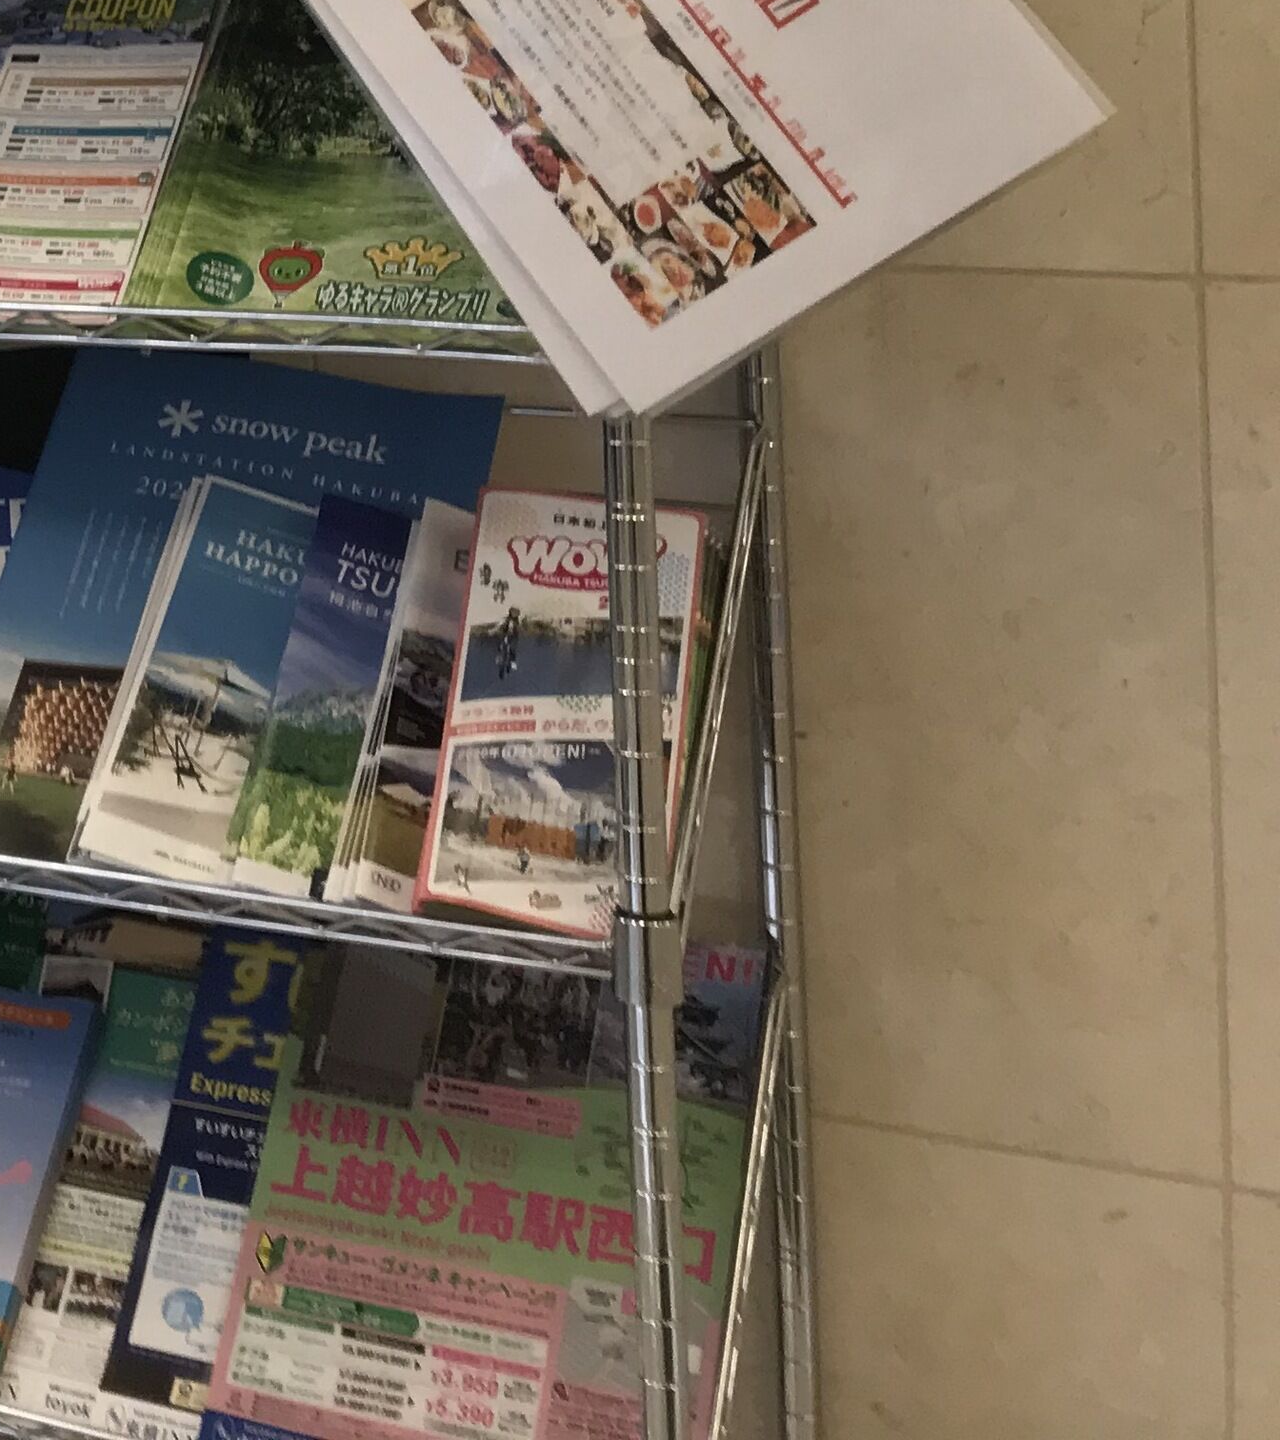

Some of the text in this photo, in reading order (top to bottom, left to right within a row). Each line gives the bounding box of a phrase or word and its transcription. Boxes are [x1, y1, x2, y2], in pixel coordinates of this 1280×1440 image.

[211, 412, 387, 465] snow peak
[110, 440, 421, 506] LANDSTATION HAKUBA
[190, 1071, 272, 1106] Express
[289, 1098, 461, 1166] 東横INN
[270, 1143, 716, 1284] 上越妙高駅西口
